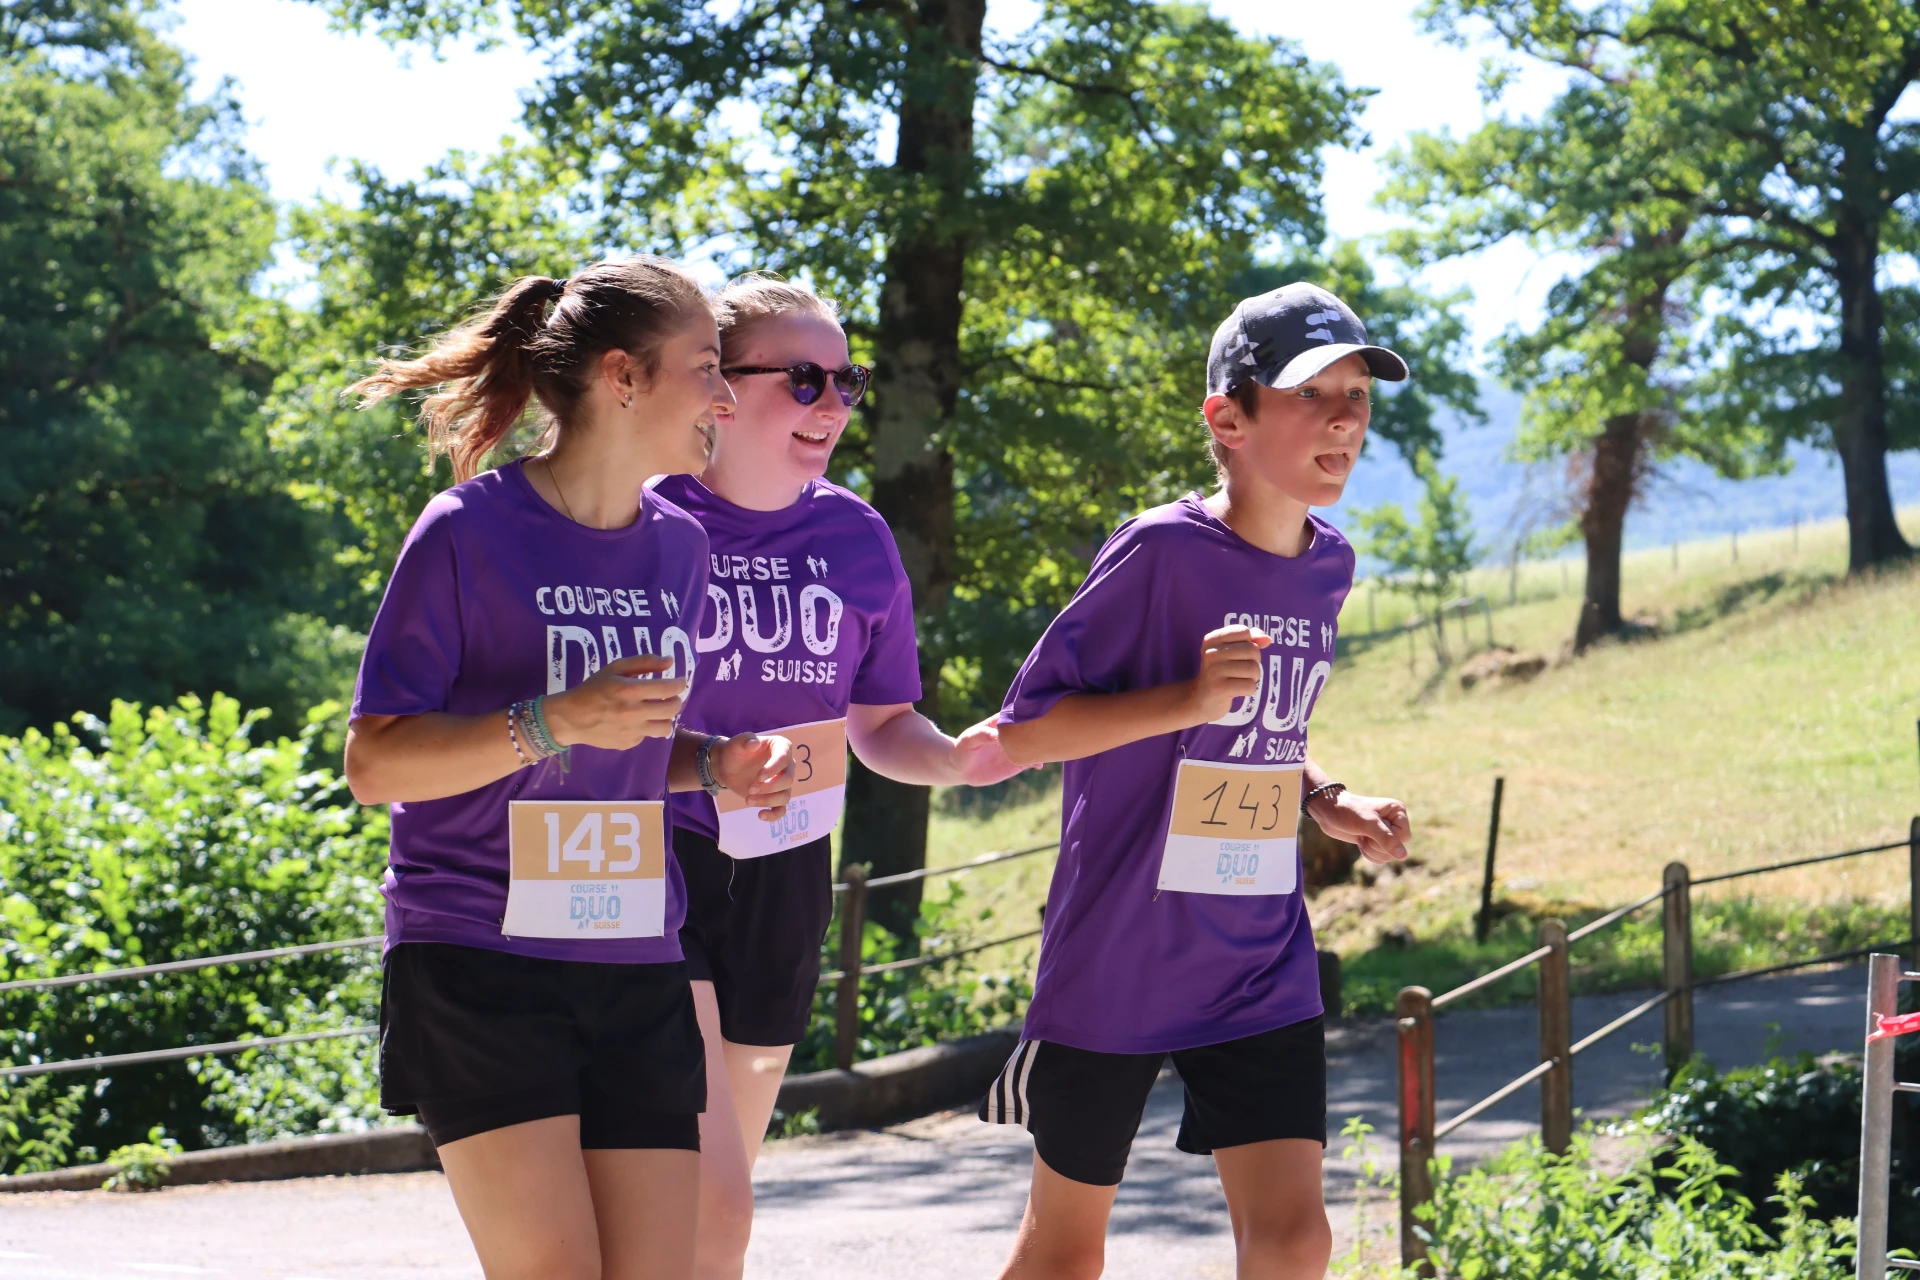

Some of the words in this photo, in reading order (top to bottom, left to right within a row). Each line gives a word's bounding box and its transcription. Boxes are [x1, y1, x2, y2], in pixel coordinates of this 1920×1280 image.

[709, 554, 791, 580] URSE
[536, 586, 651, 617] COURSE
[695, 583, 843, 656] DUO
[761, 659, 837, 684] SUISSE
[1201, 781, 1281, 830] 143
[770, 809, 809, 838] DUO
[544, 812, 641, 873] 143
[790, 831, 809, 843] SUISSE
[1220, 842, 1251, 851] COURSE
[1216, 853, 1259, 876] DUO
[571, 884, 607, 893] COURSE
[1234, 877, 1256, 885] SUISSE
[570, 895, 620, 920] DUO
[594, 921, 620, 929] SUISSE
